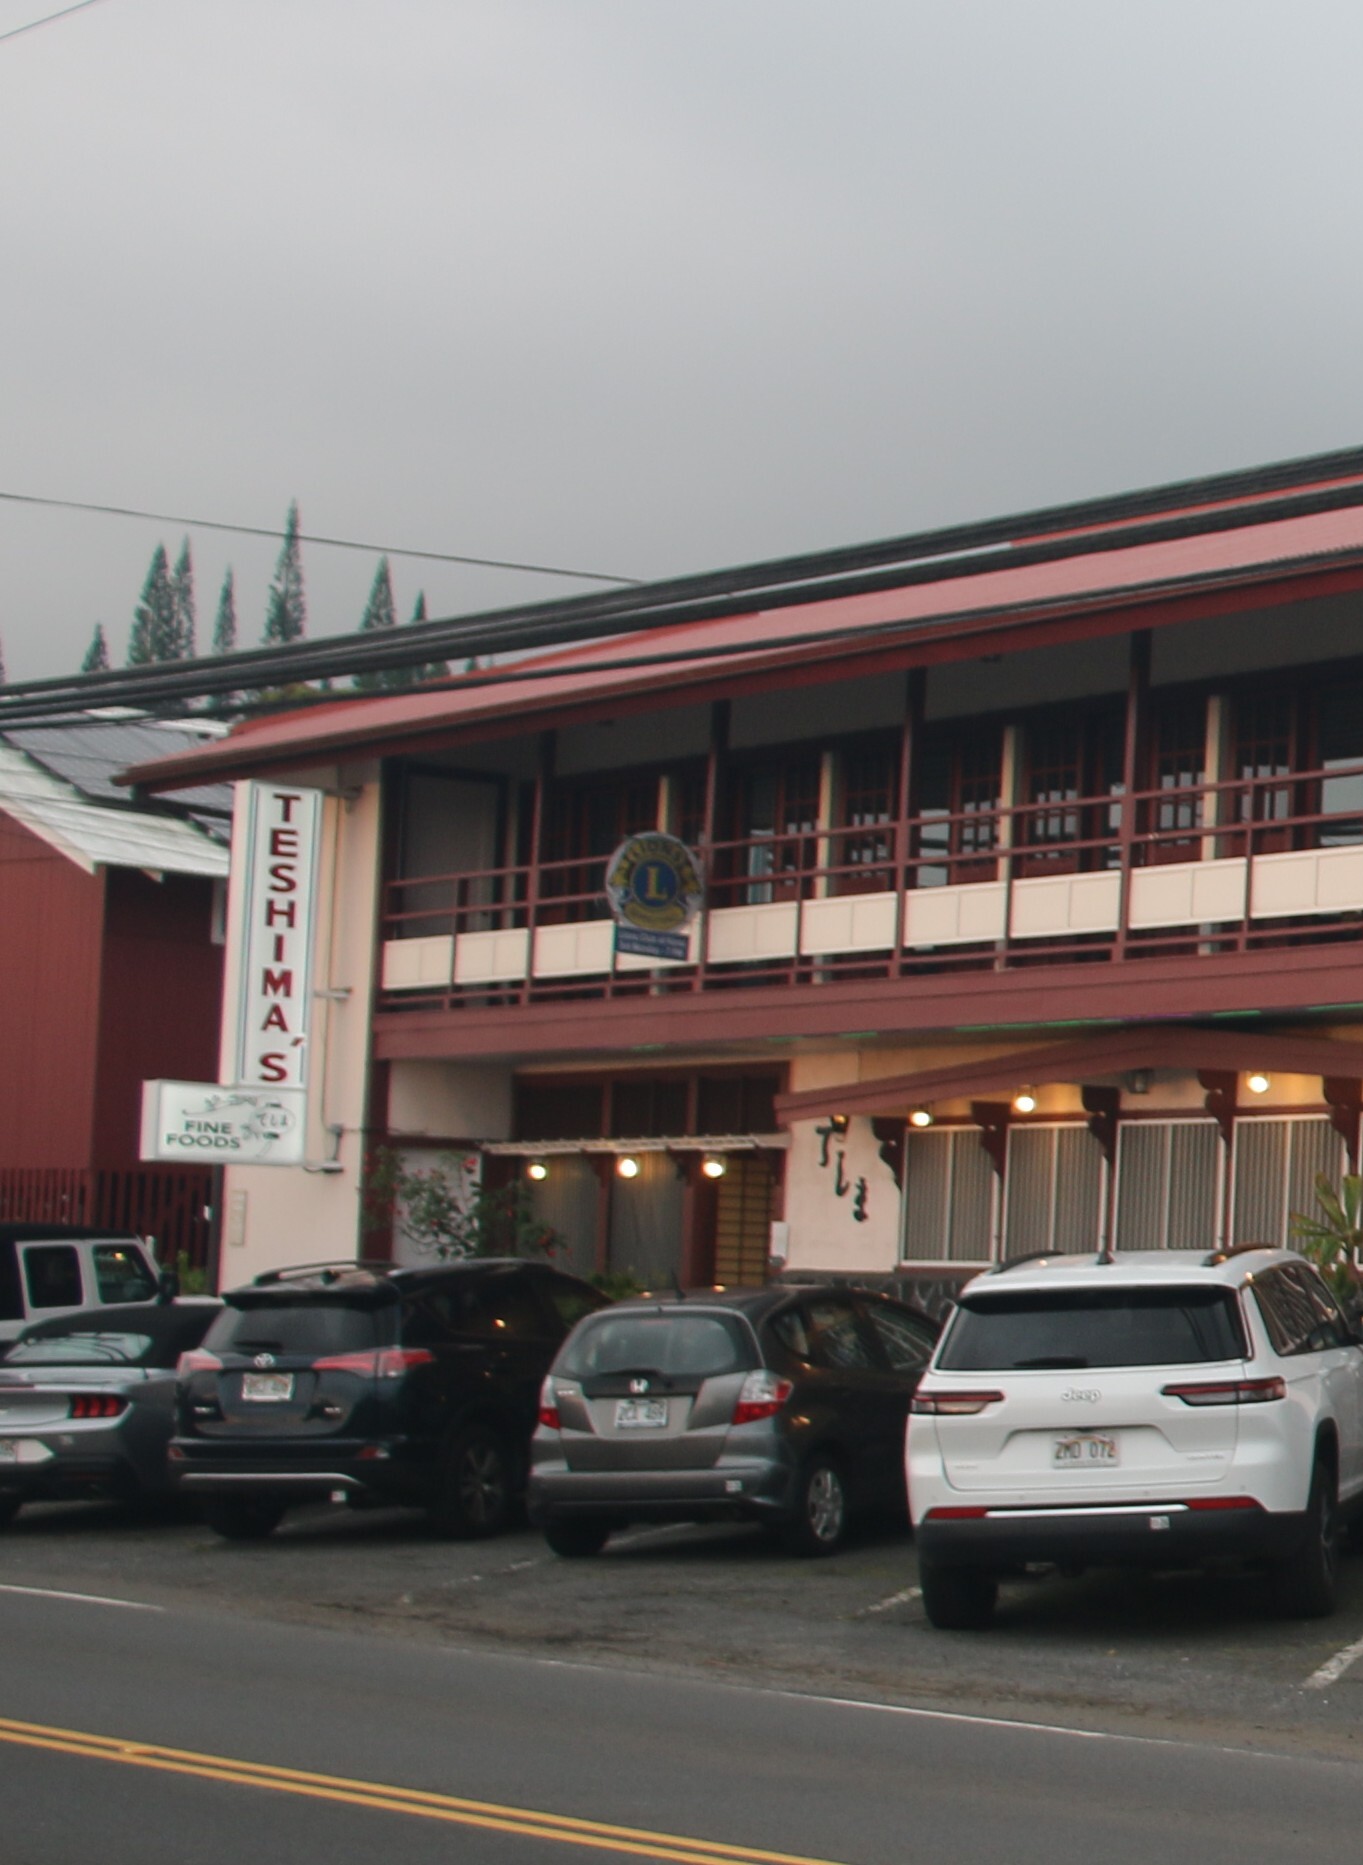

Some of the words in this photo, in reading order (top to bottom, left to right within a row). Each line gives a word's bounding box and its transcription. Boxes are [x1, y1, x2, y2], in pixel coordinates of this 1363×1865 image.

[646, 866, 668, 899] L
[258, 793, 304, 1083] TESHIMA'S
[184, 1120, 233, 1135] FINE
[166, 1133, 241, 1149] FOODS
[1061, 1386, 1102, 1403] Jeep
